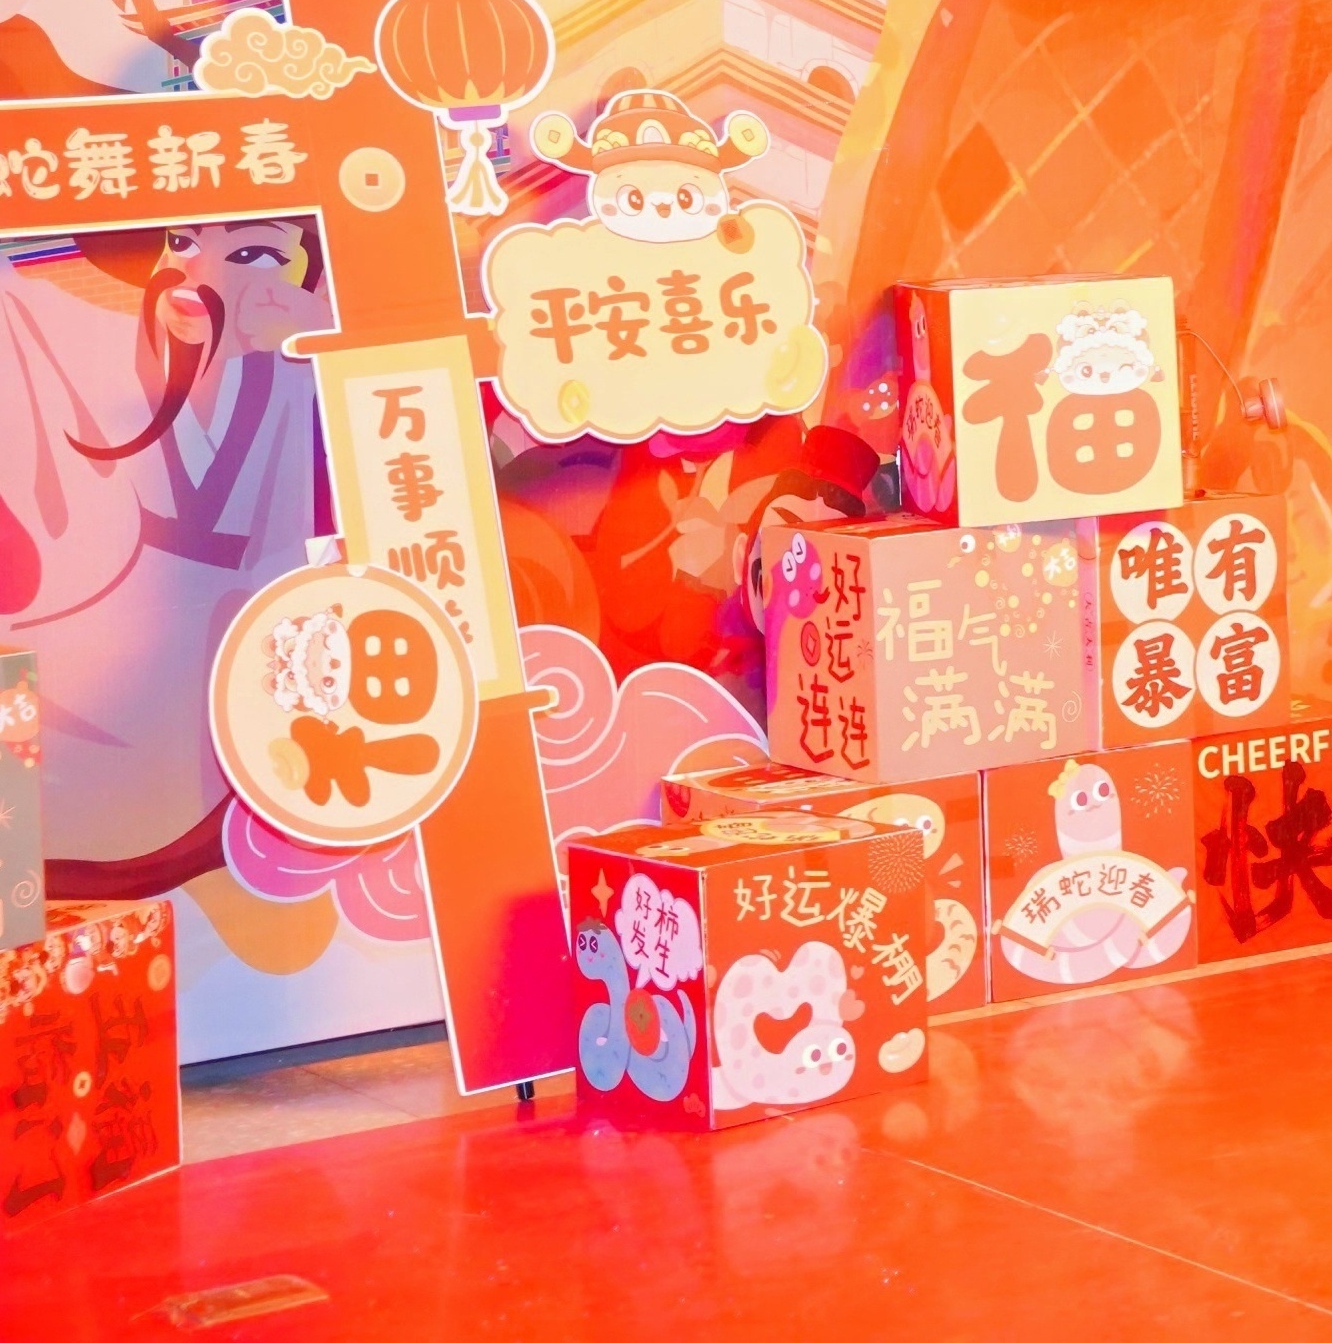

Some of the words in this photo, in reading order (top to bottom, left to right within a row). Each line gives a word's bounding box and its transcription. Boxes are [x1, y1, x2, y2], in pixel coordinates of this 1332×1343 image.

[530, 269, 777, 364] 平安喜乐
[962, 332, 1162, 503] 福
[372, 385, 474, 645] 万事顺
[1117, 520, 1268, 609] 唯有
[797, 552, 870, 771] 好运连连
[876, 578, 1008, 677] 福气
[1123, 622, 1272, 716] 暴富
[288, 608, 441, 808] 福
[901, 666, 1058, 753] 满满
[635, 885, 680, 940] 好柿
[734, 866, 925, 1006] 好运爆棚
[1021, 864, 1155, 925] 瑞蛇迎春
[631, 920, 672, 979] 发生
